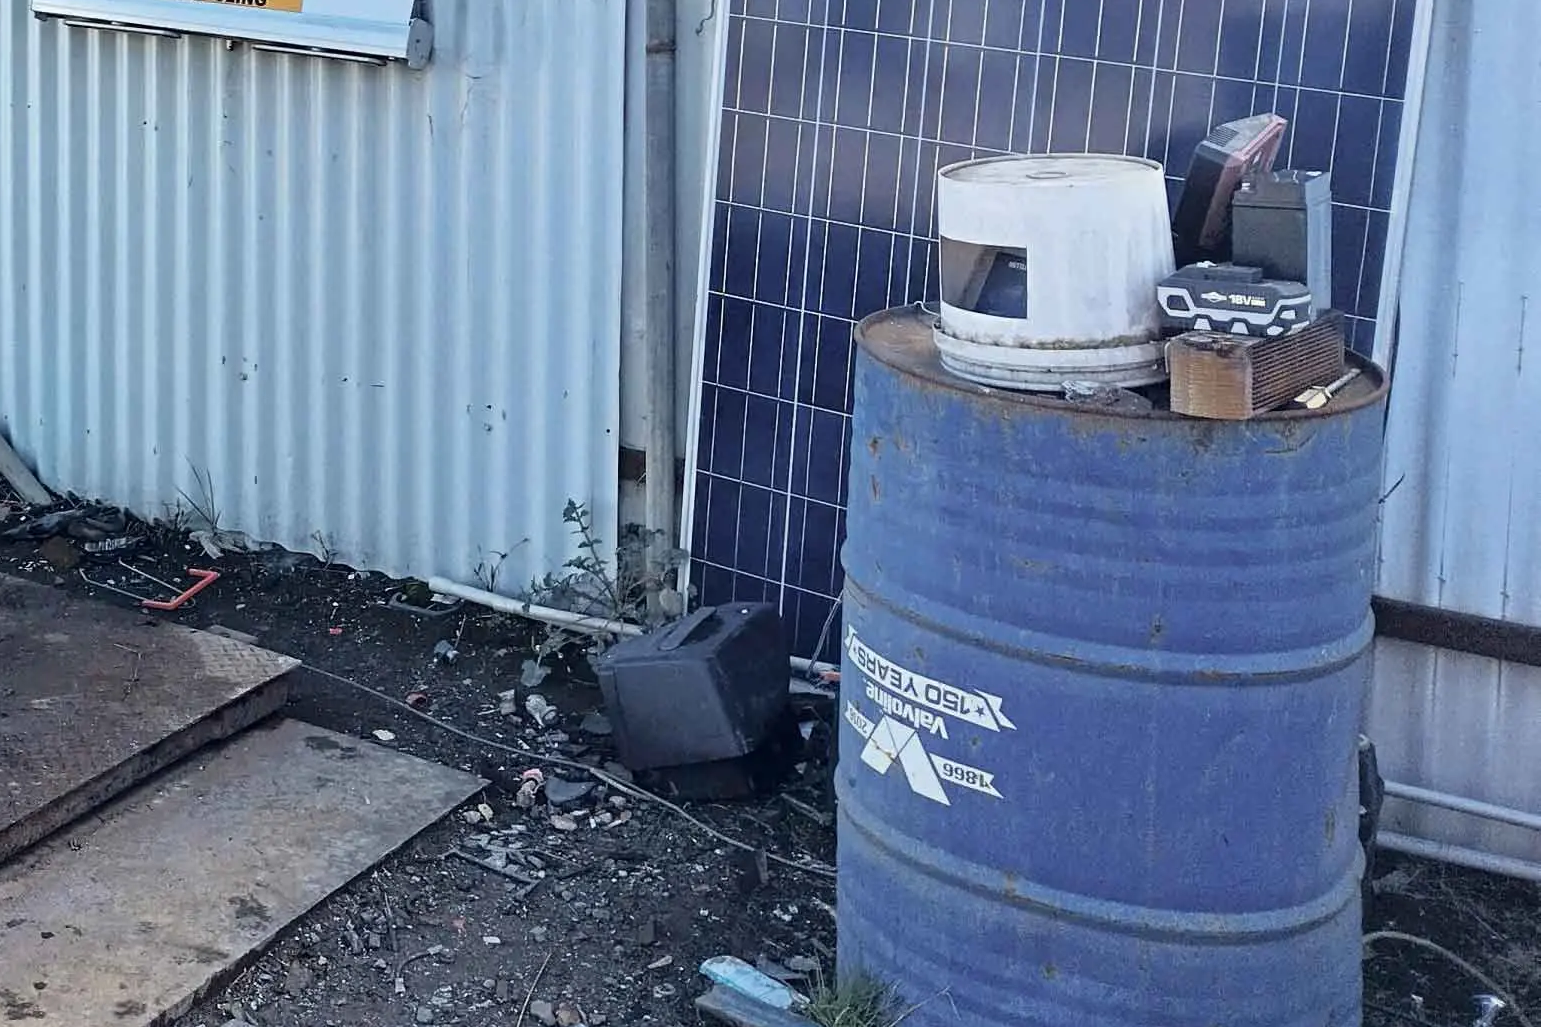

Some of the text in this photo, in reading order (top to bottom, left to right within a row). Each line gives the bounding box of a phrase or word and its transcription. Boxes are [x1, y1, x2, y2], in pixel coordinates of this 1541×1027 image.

[858, 647, 970, 714] 150 YEARS
[865, 682, 949, 740] Valvoline
[943, 762, 991, 789] 1866
